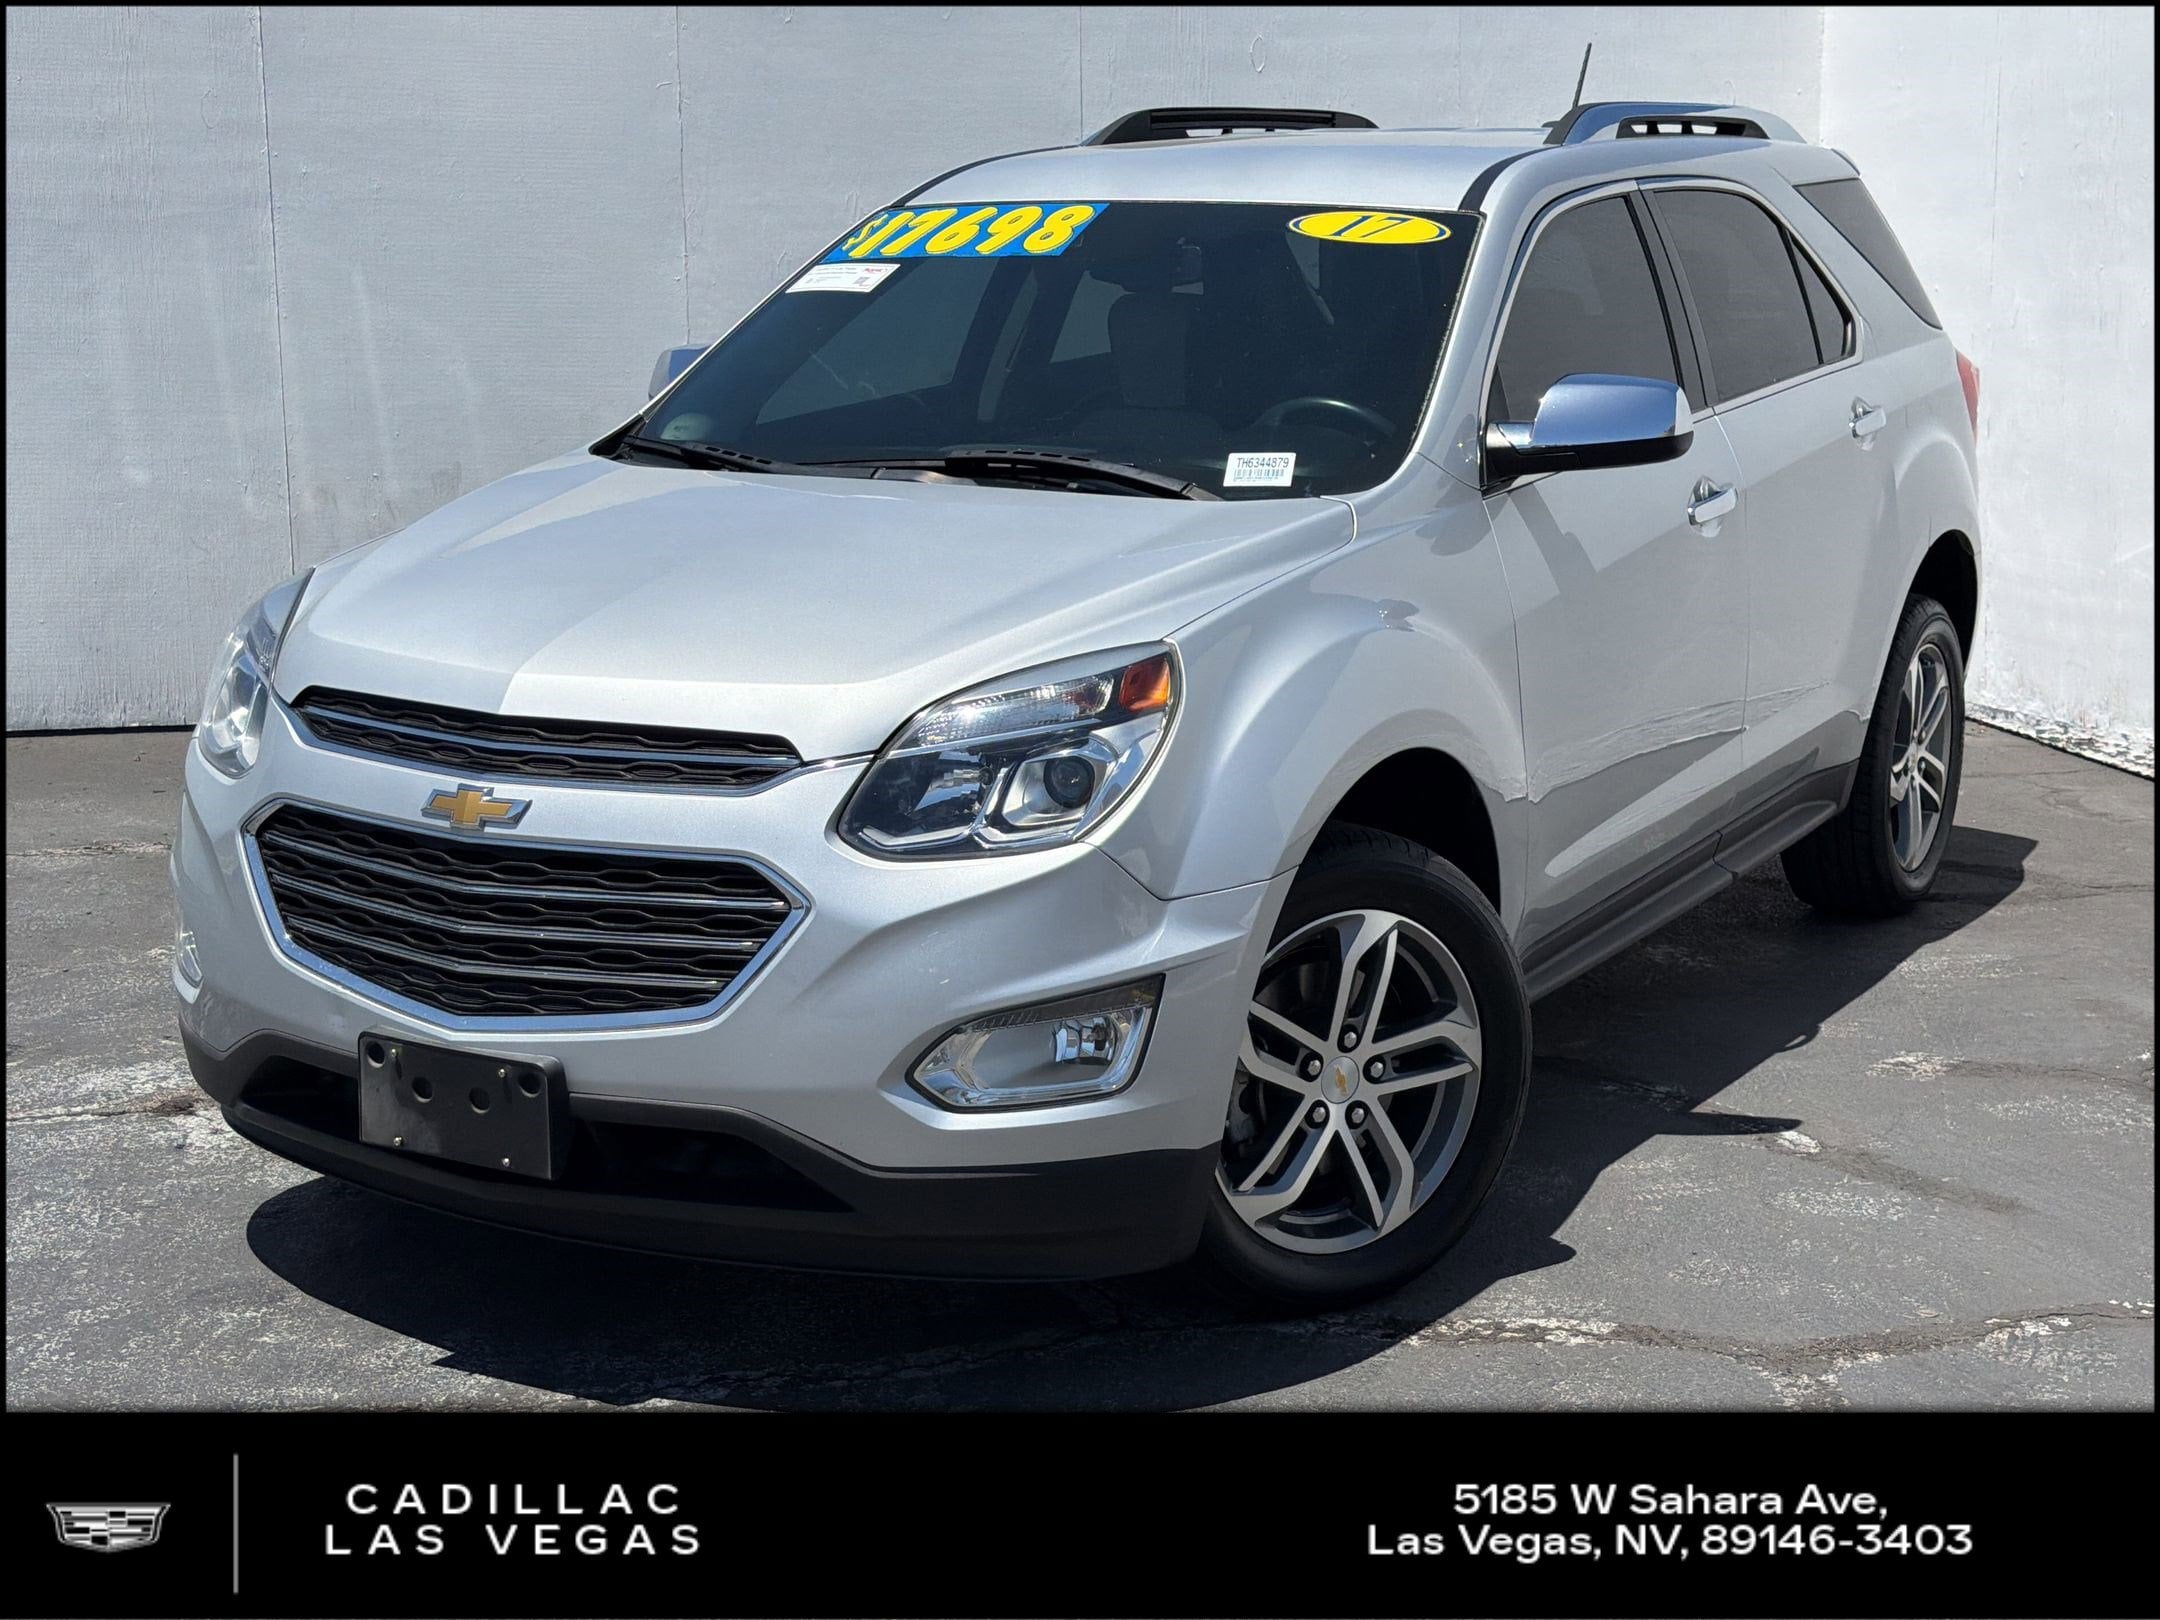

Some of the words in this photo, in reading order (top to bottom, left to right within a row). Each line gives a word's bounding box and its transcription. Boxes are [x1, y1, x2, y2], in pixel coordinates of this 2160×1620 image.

[841, 205, 1096, 259] $17698
[1329, 215, 1414, 238] 17
[1237, 457, 1290, 469] TH6344879
